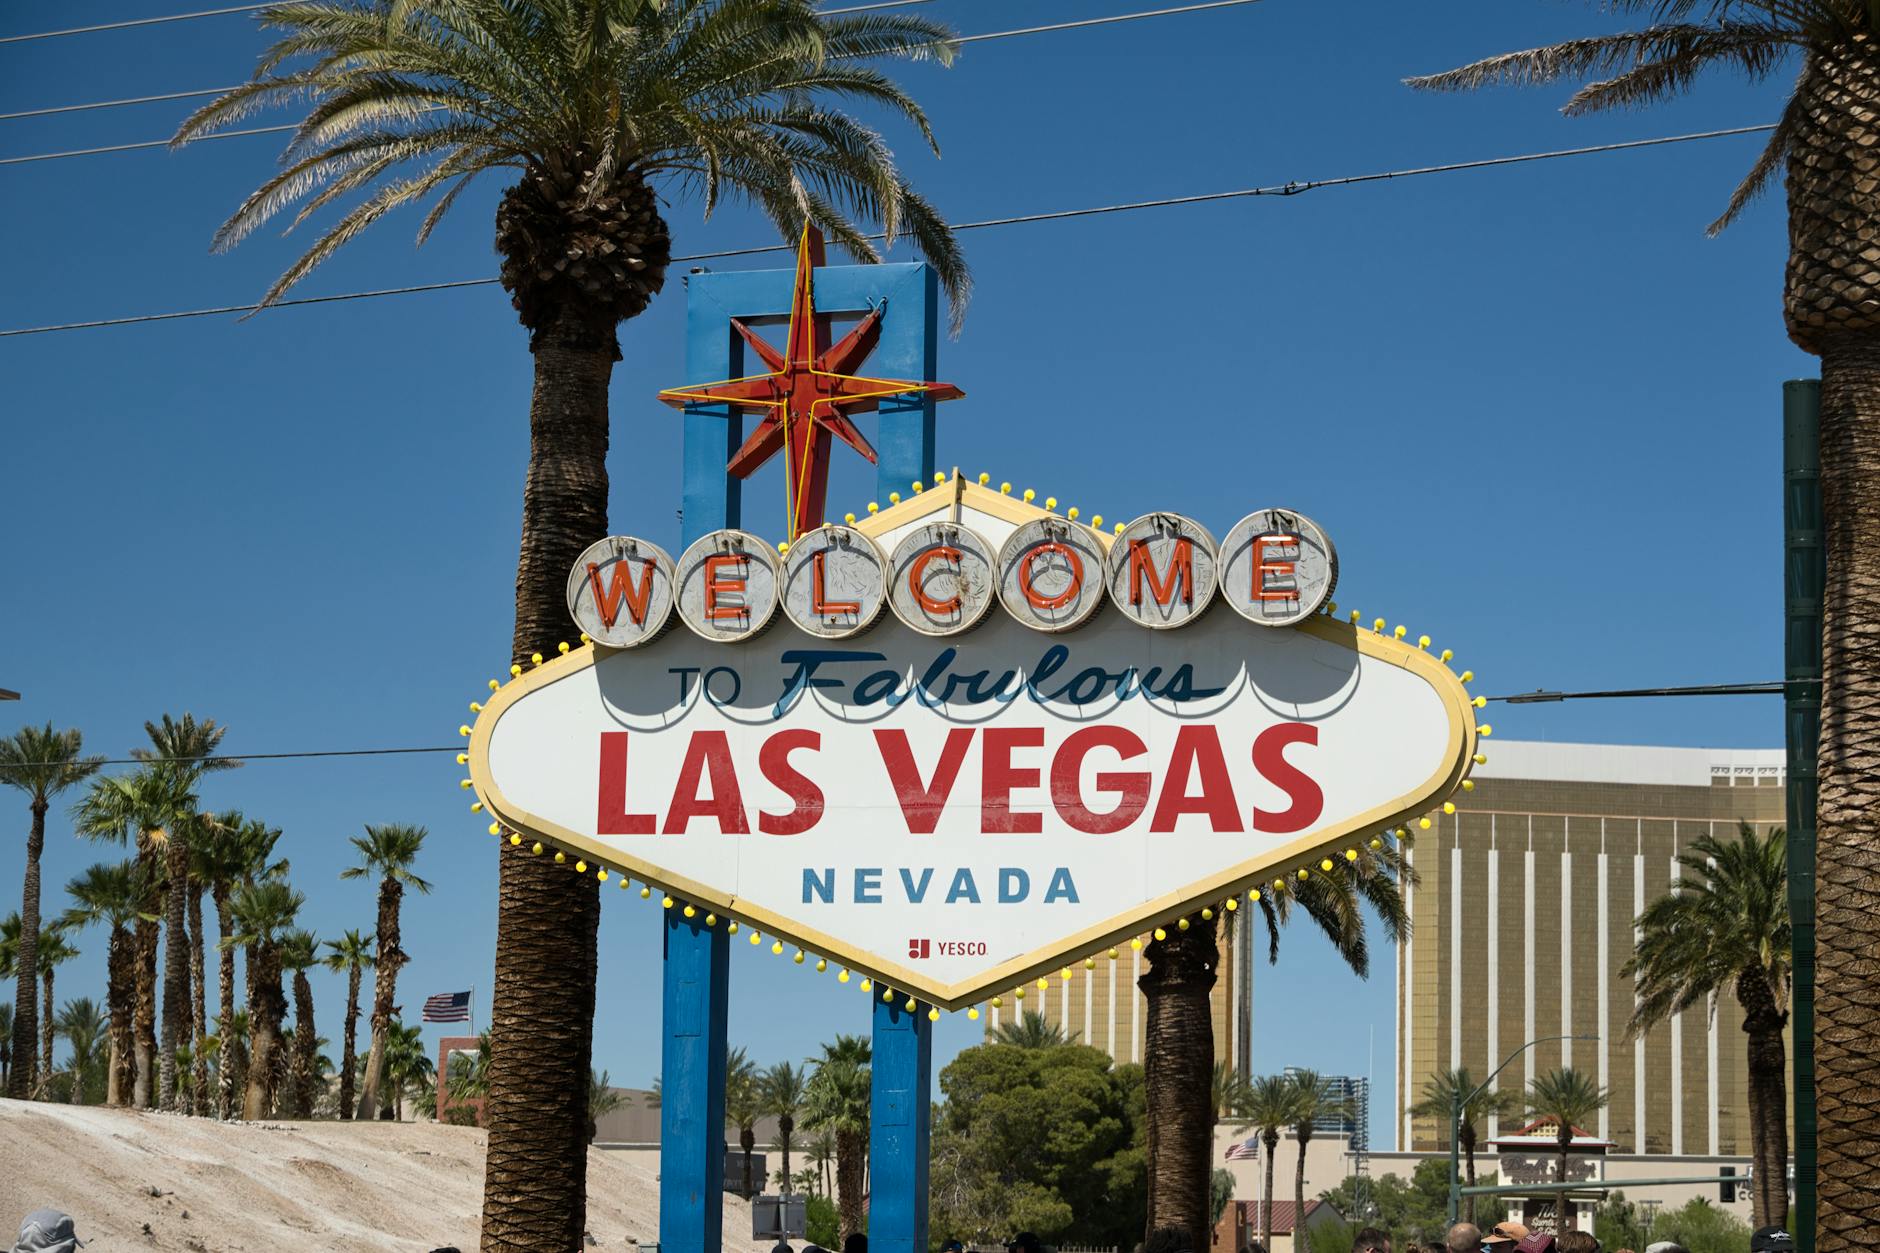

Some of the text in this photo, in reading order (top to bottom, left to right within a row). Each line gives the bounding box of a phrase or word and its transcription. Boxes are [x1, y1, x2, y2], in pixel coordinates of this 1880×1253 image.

[586, 534, 1301, 630] WELCOME
[668, 644, 1227, 720] TO Fabulous
[597, 721, 1325, 836] LAS VEGAS
[802, 867, 1081, 905] NEVADA
[938, 942, 987, 956] YESCO
[1538, 1203, 1560, 1218] Tik
